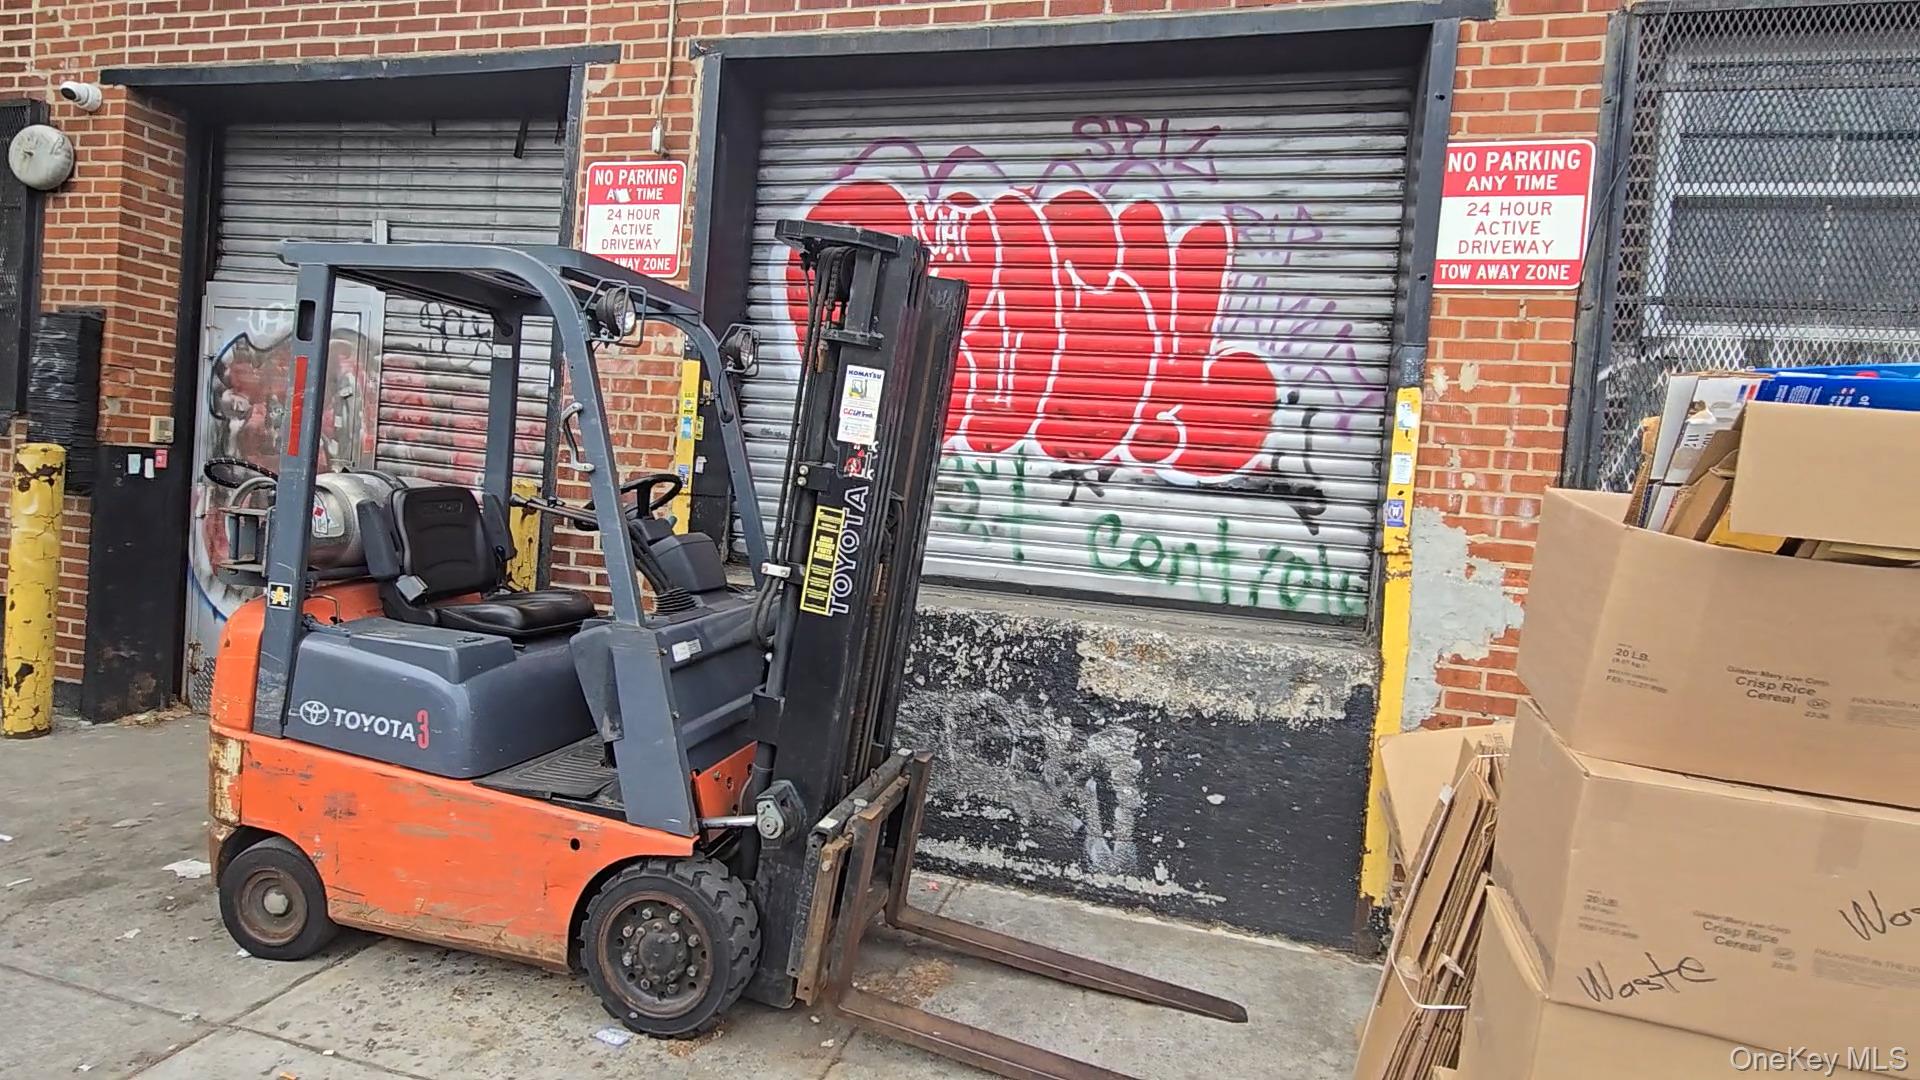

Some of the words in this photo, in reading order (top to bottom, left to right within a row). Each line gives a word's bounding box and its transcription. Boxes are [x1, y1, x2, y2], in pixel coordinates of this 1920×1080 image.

[1447, 152, 1476, 173] NO
[1486, 150, 1581, 172] PARKING
[595, 170, 614, 185] NO
[618, 169, 678, 185] PARKING
[1466, 175, 1507, 191] ANY
[1514, 175, 1558, 191] TIME
[636, 188, 664, 200] TIME
[607, 209, 622, 220] 24
[628, 208, 660, 220] HOUR
[1466, 202, 1490, 216] 24
[1500, 202, 1553, 216] HOUR
[612, 223, 653, 235] ACTIVE
[1475, 221, 1541, 235] ACTIVE
[601, 238, 661, 251] DRIVEWAY
[1458, 239, 1554, 254] DRIVEWAY
[643, 258, 671, 270] ZONE
[1440, 264, 1471, 279] TOW
[1476, 264, 1520, 280] AWAY
[1525, 264, 1571, 280] ZONE
[848, 370, 882, 379] KOMATSU
[829, 485, 869, 618] TOYOTA
[1615, 648, 1630, 658] 20
[1735, 676, 1777, 691] Crisp
[1781, 682, 1817, 697] Rice
[1746, 688, 1797, 705] Cereal
[333, 707, 416, 742] TOYOTA
[416, 709, 430, 749] 3
[1585, 894, 1599, 904] 20
[1702, 920, 1742, 938] Crisp
[1746, 929, 1779, 944] Rice
[1714, 935, 1763, 953] Cereal
[1576, 951, 1717, 1003] Waste
